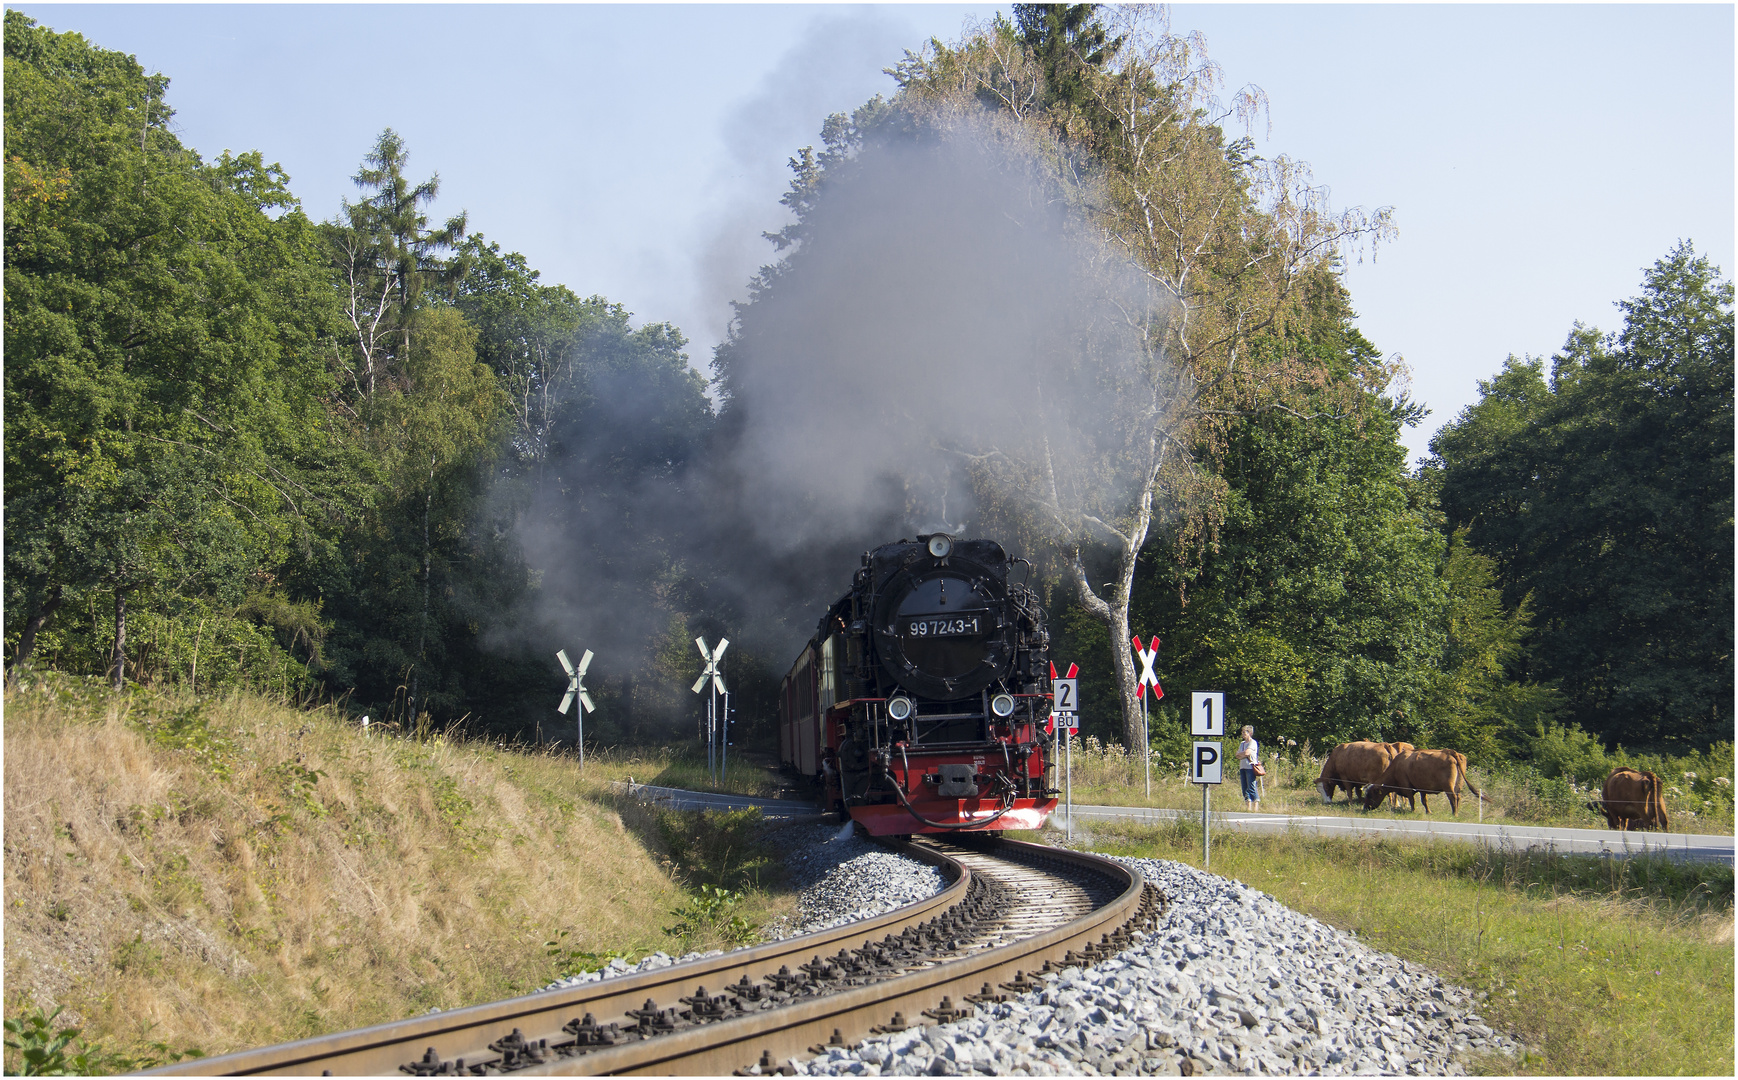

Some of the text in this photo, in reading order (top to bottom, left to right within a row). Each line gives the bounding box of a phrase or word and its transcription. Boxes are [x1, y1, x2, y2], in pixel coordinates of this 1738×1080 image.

[910, 618, 978, 636] 99 7243-1
[1060, 683, 1071, 707] 2
[1202, 698, 1213, 730] 1
[1196, 746, 1218, 777] P
